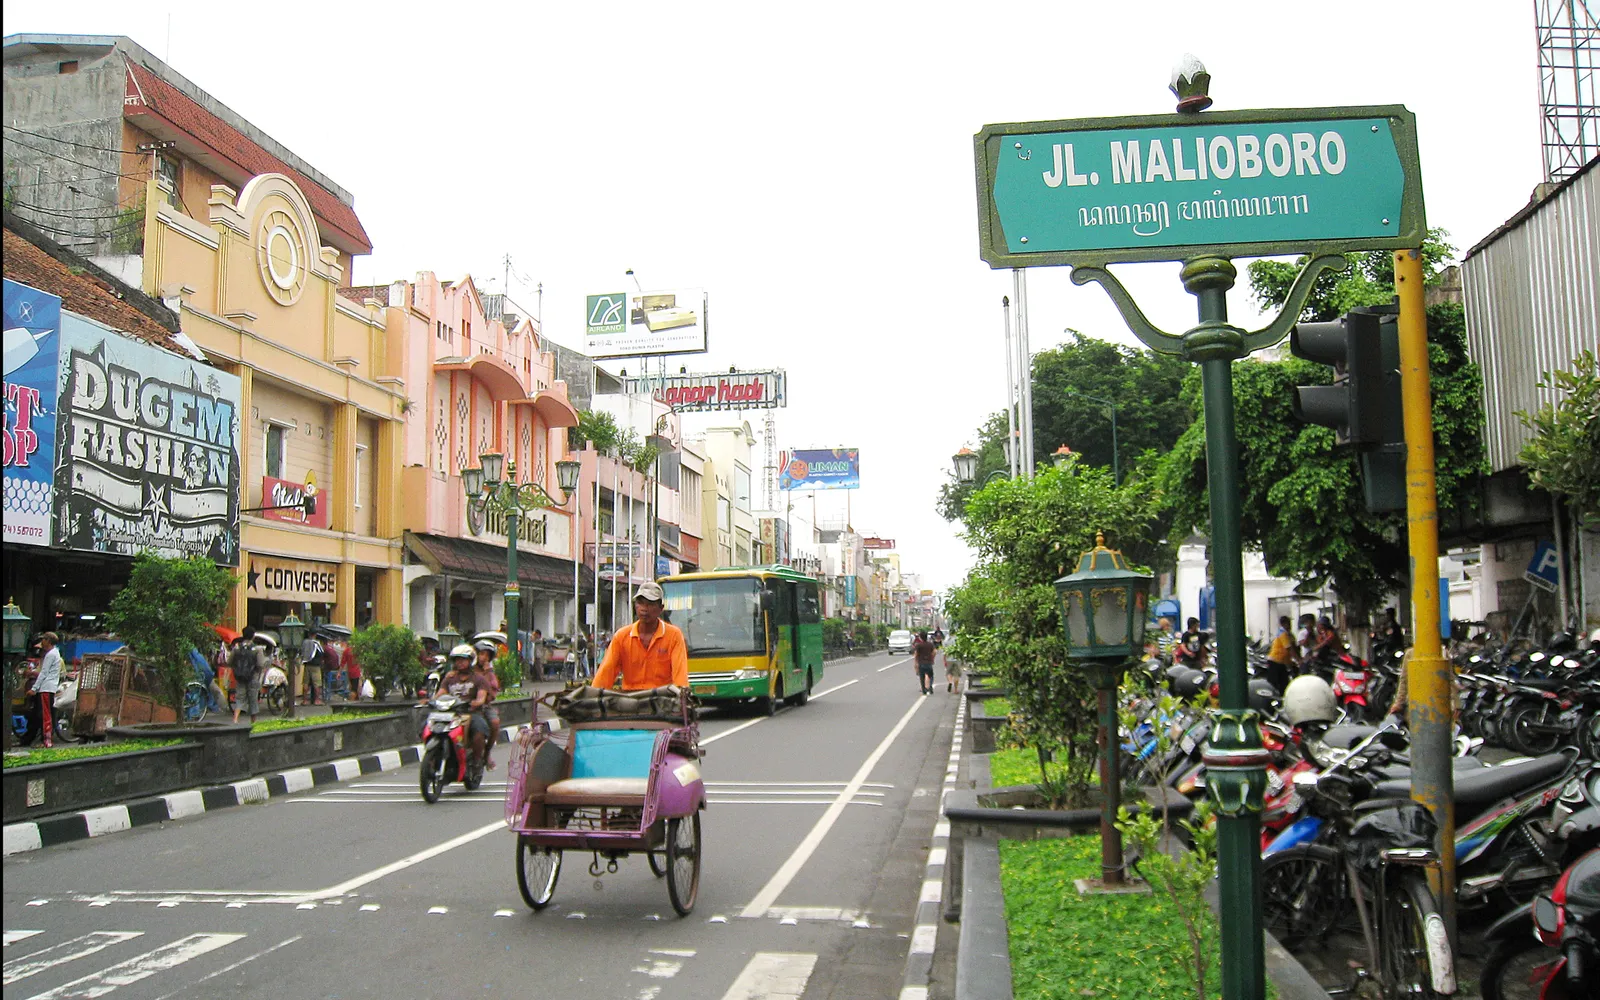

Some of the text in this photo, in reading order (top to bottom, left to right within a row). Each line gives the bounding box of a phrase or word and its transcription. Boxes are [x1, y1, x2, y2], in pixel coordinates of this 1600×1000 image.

[1042, 131, 1347, 188] JL. MALIOBORO
[588, 325, 622, 333] AIRLAND
[72, 357, 233, 448] DUGEM
[654, 385, 716, 405] anar
[808, 460, 849, 473] LIMAN
[485, 507, 547, 545] maahari
[1537, 547, 1558, 573] P
[264, 567, 335, 593] CONVERSE
